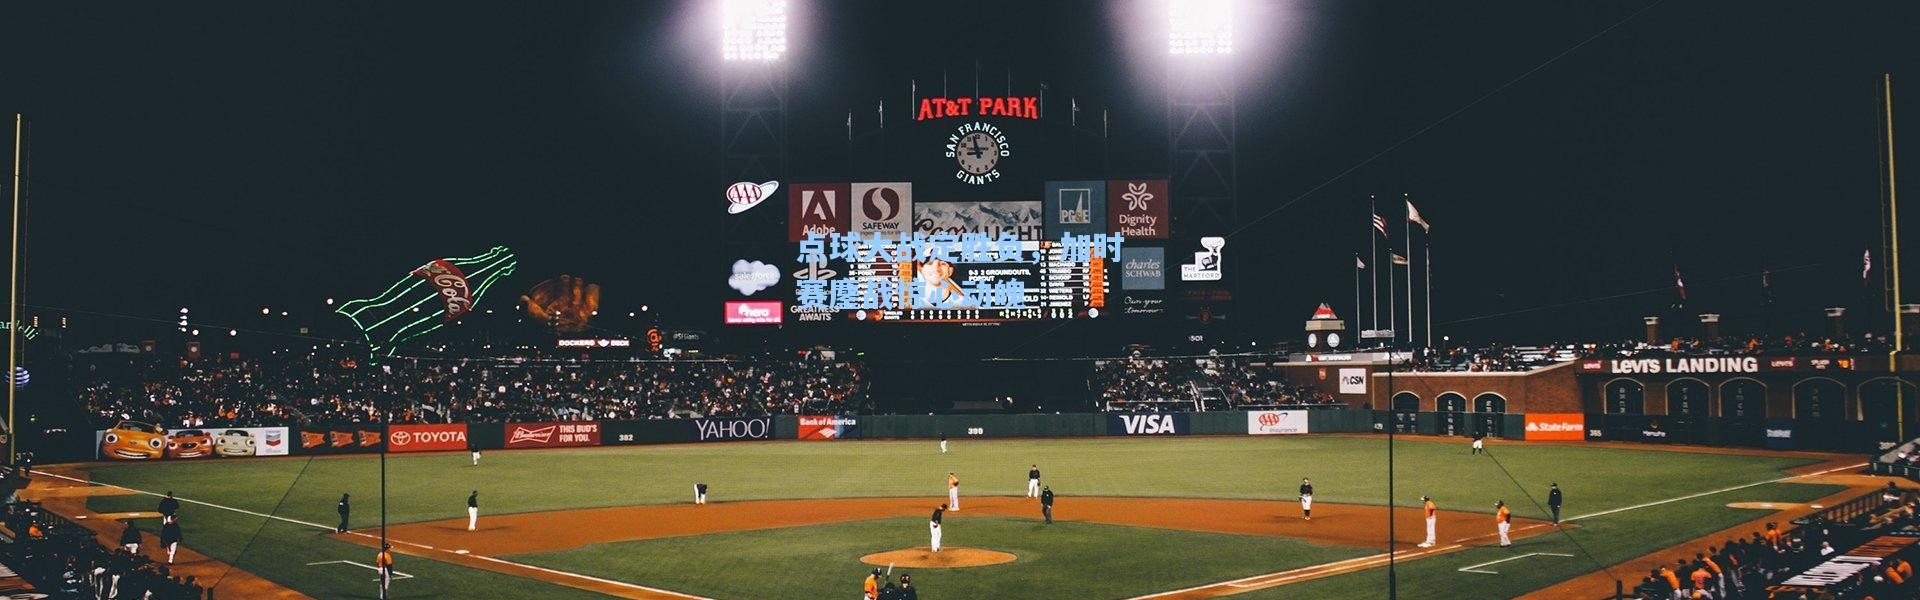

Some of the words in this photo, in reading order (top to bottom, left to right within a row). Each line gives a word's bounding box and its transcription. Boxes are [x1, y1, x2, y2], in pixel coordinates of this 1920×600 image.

[918, 98, 972, 120] AT&T
[979, 97, 1038, 119] PARK
[945, 134, 960, 158] SAN
[958, 121, 1010, 157] FRANCISCO
[956, 169, 1000, 185] GIANTS
[1061, 209, 1090, 222] PG&E
[1119, 214, 1157, 226] Dignity
[802, 224, 836, 236] Adobe
[862, 222, 899, 230] SAFEWAY
[1121, 226, 1155, 236] Health
[1125, 260, 1160, 270] charles
[1125, 269, 1161, 278] SCHWAB
[799, 313, 832, 321] AWAITS
[1666, 357, 1758, 373] LANDING
[1350, 376, 1364, 385] CSN
[800, 418, 818, 426] Bank
[818, 418, 827, 426] of
[827, 418, 856, 426] America
[1119, 414, 1175, 434] VISA
[560, 425, 575, 433] THIS
[577, 424, 597, 432] BUD'S
[695, 419, 770, 440] YAHOO!
[413, 431, 466, 443] TOYOTA
[515, 430, 552, 439] Budweiser
[560, 434, 573, 442] FOR
[574, 434, 590, 442] YOU.
